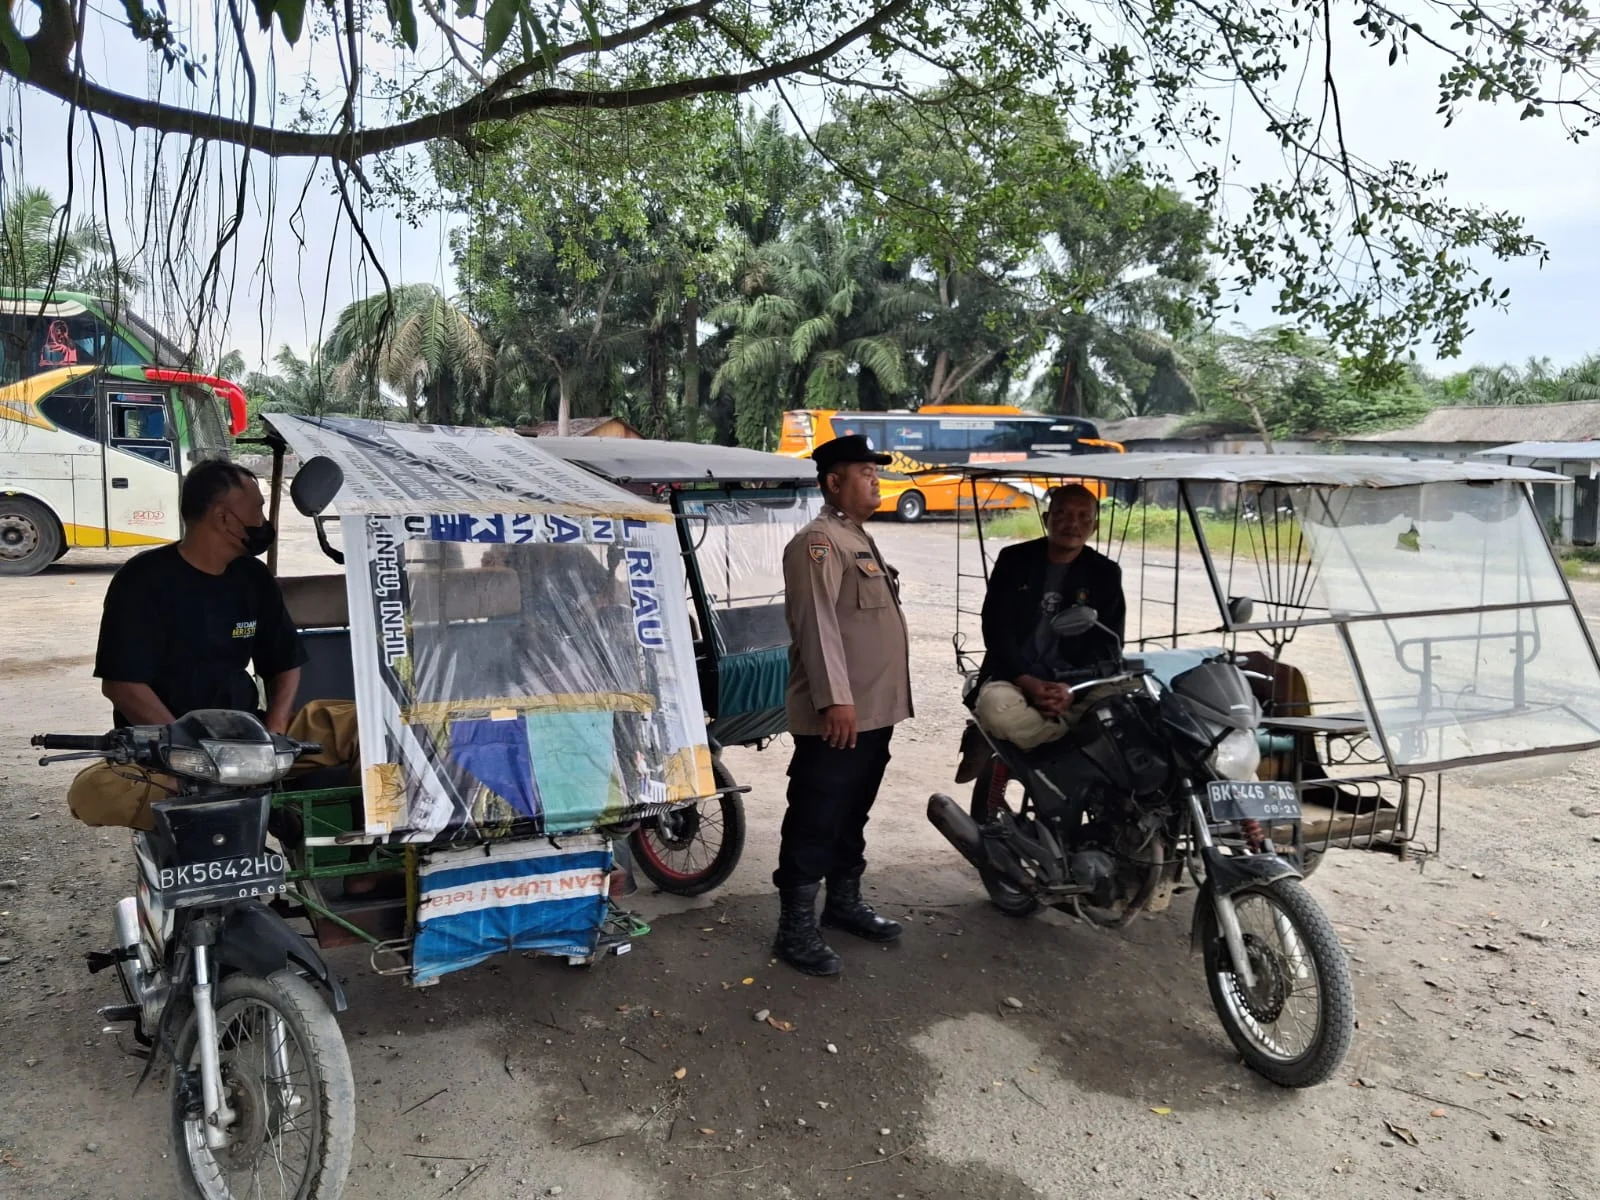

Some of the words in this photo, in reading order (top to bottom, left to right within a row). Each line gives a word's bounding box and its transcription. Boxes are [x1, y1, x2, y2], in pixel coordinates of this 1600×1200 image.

[376, 533, 398, 596] INHU,
[626, 550, 665, 648] RIAU
[381, 602, 405, 664] INHIL
[494, 880, 553, 900] LUPA
